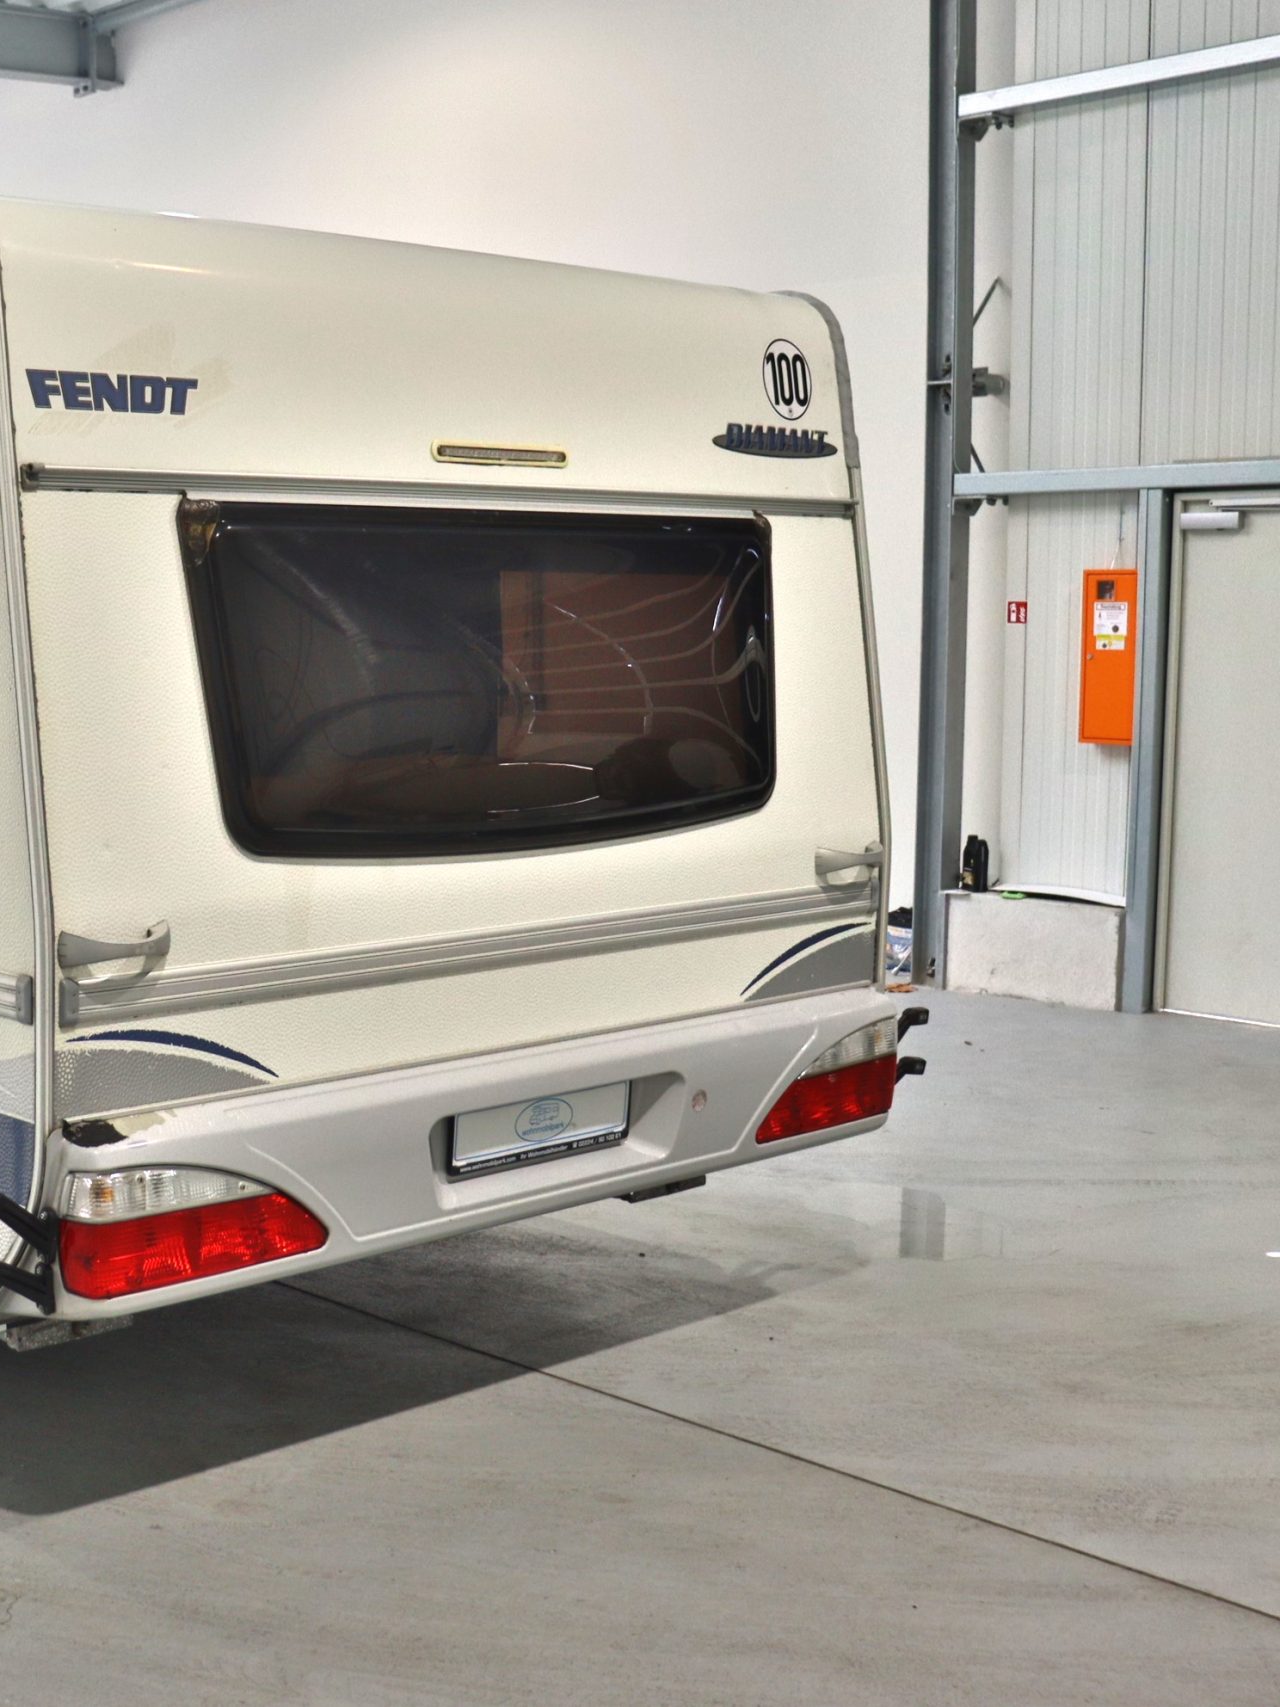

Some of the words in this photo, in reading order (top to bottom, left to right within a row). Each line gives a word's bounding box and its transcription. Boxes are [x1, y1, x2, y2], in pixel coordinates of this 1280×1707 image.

[25, 368, 198, 415] FENDT
[766, 352, 808, 407] 100
[726, 422, 828, 455] DIAMANT
